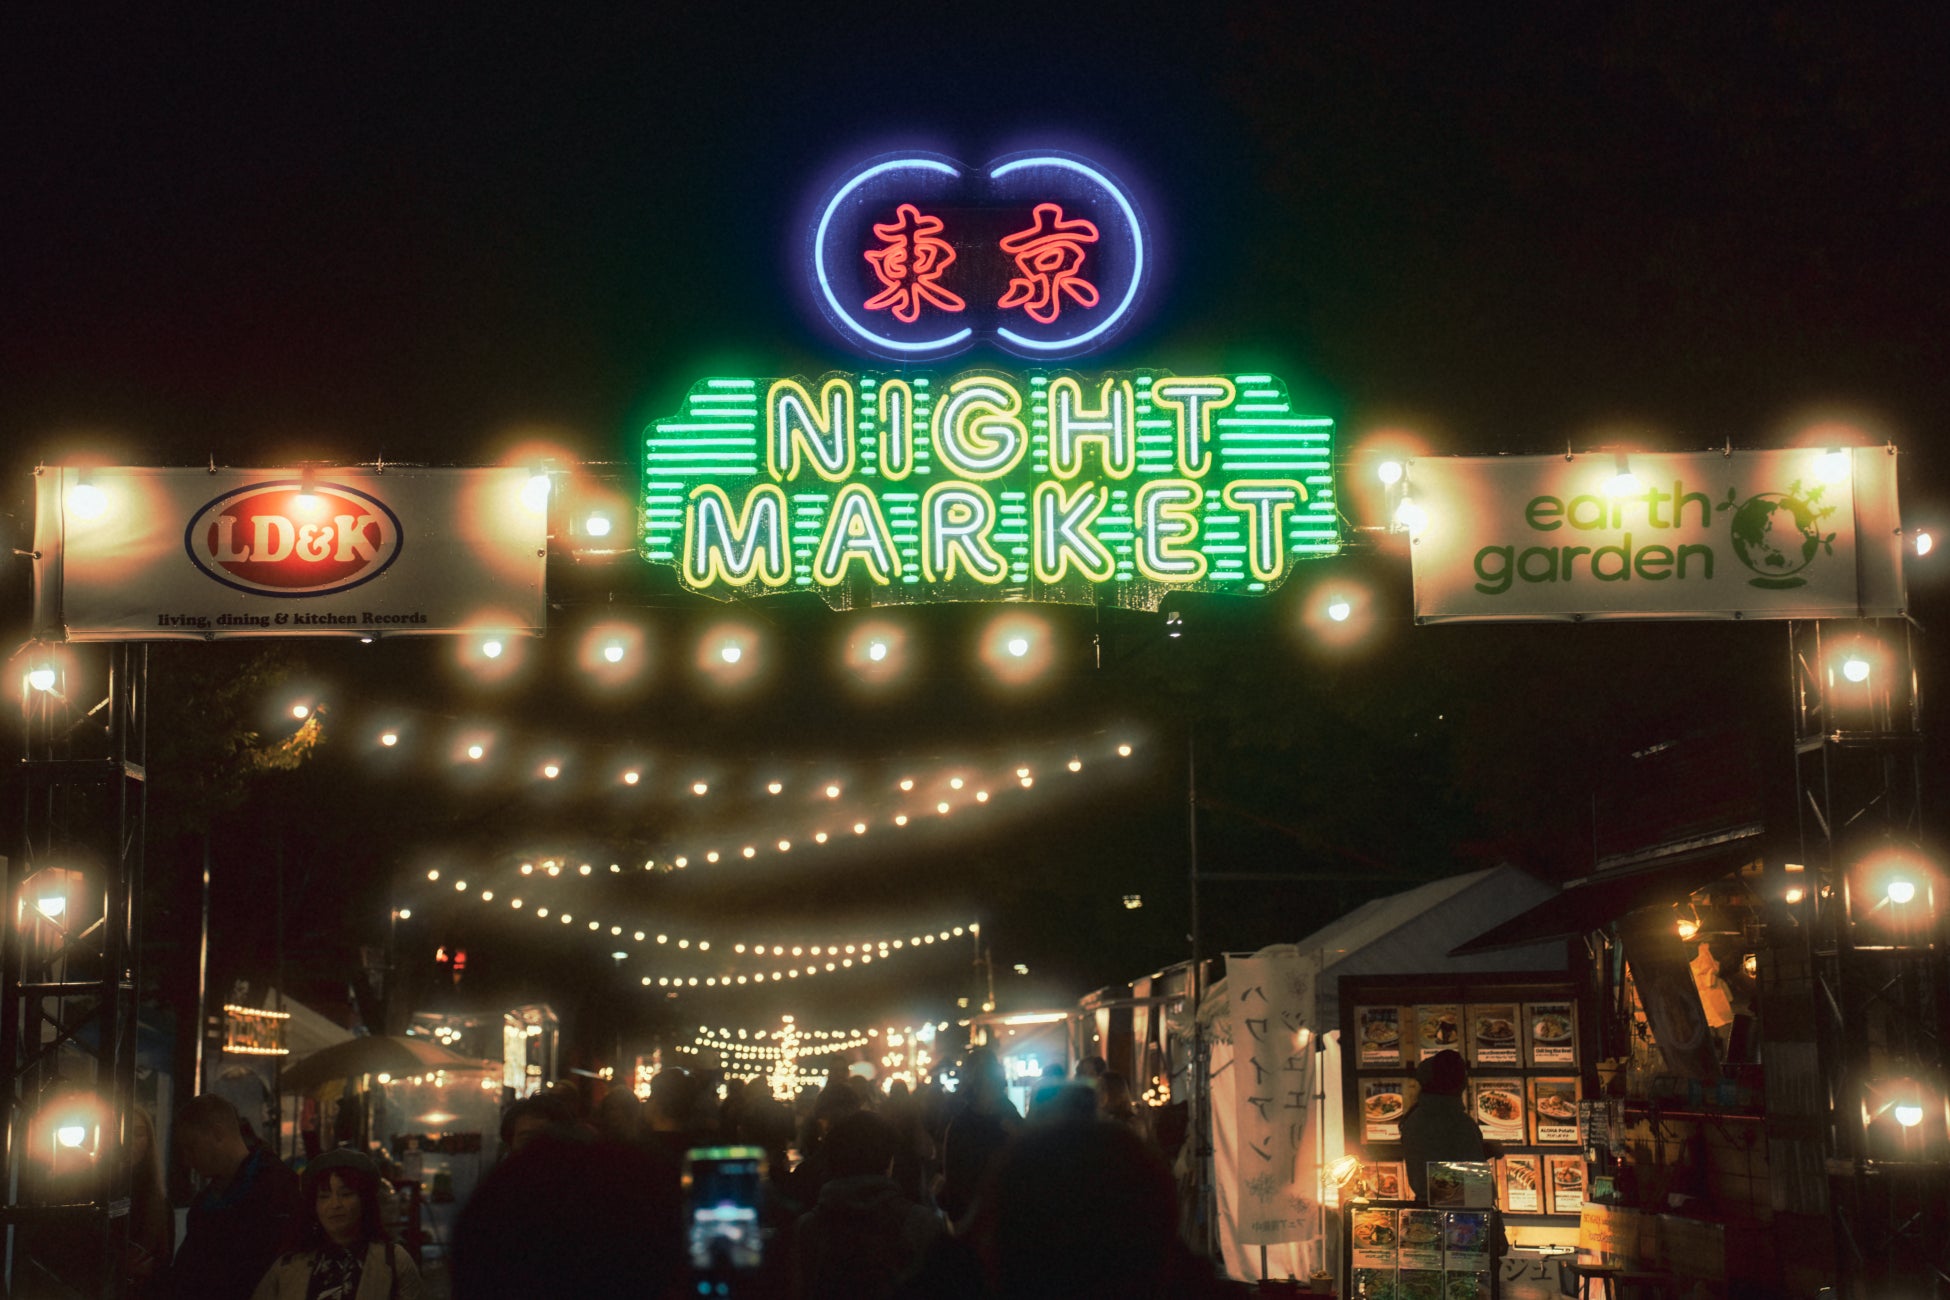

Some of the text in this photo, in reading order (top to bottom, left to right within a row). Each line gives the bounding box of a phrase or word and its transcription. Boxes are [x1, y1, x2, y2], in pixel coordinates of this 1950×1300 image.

[863, 202, 1100, 323] 東京
[766, 376, 1235, 481] NIGHT
[683, 478, 1307, 588] MARKET
[1525, 480, 1711, 531] earth
[214, 514, 377, 562] LD&K
[1474, 532, 1713, 595] garden
[158, 611, 428, 628] living, dining & kitchen Records
